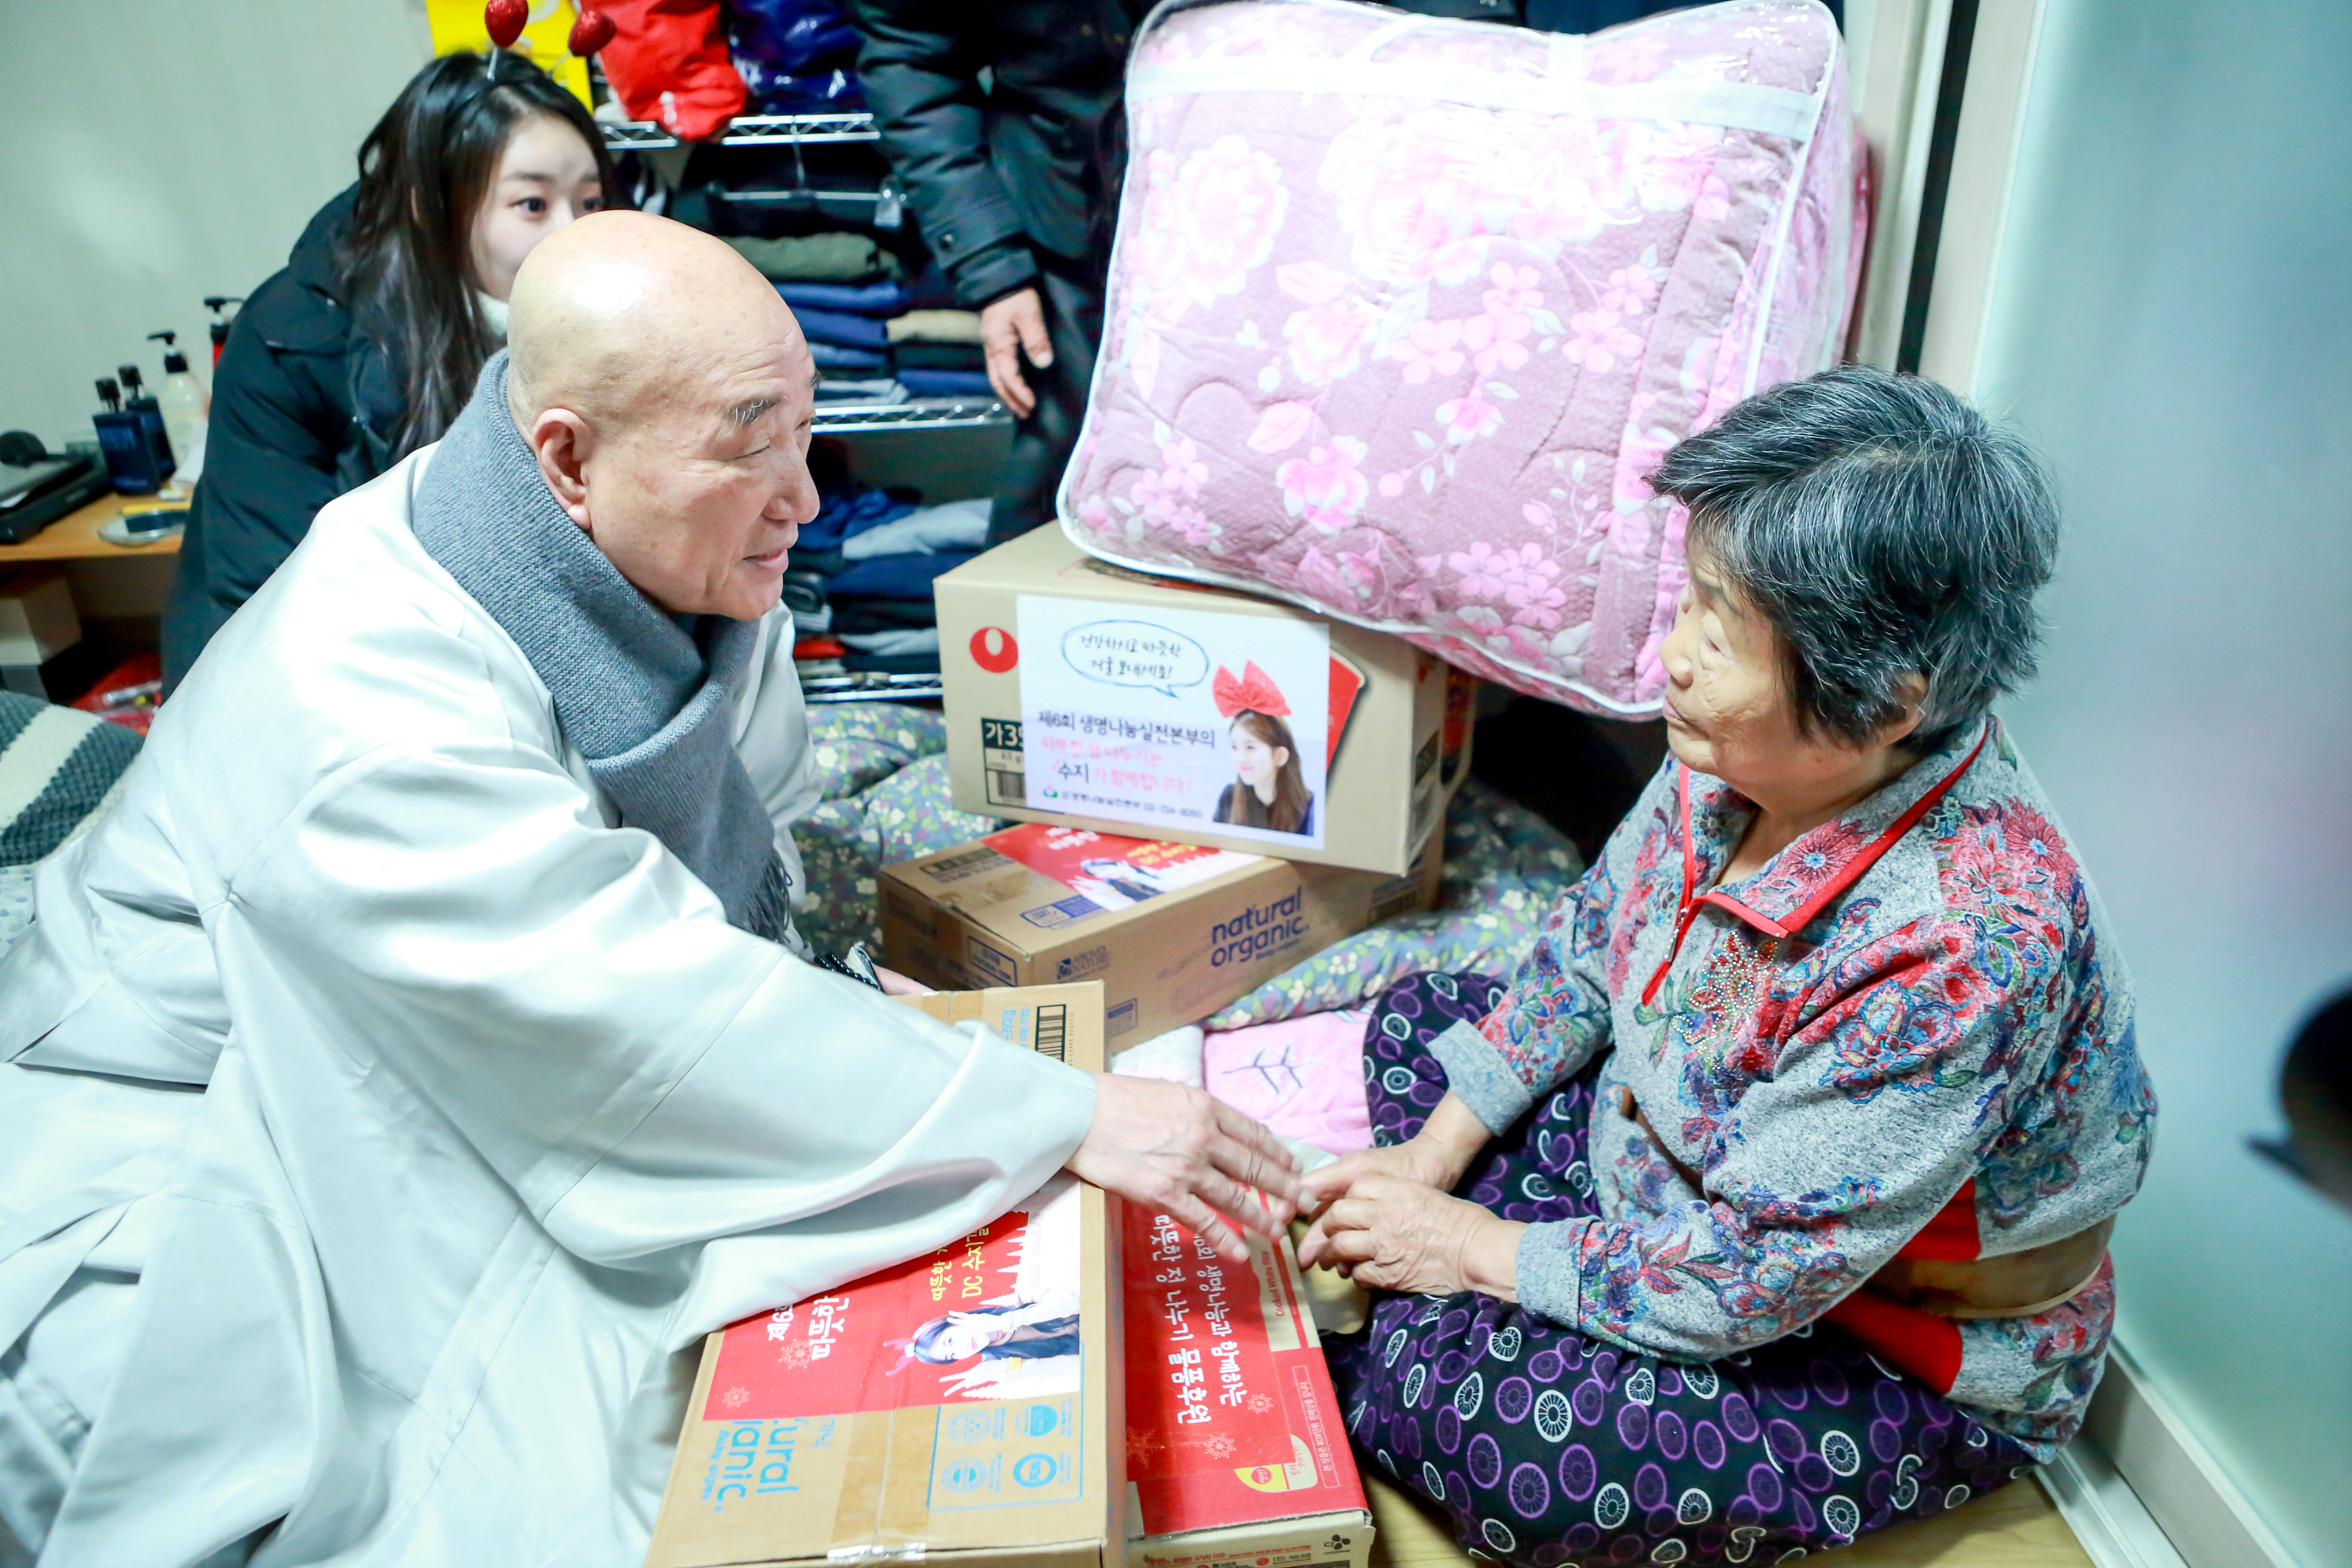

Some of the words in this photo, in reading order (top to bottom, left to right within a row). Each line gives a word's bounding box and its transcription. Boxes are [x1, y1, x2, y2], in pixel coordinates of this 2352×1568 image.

[1212, 885, 1301, 944] natural
[1211, 916, 1305, 967] organic
[1149, 1215, 1181, 1262] 따뜻한
[930, 1261, 952, 1301] 따뜻한
[962, 1276, 983, 1298] DC
[1155, 1268, 1186, 1284] 정
[1196, 1265, 1232, 1337] 생명나눔과
[808, 1295, 849, 1359] 따뜻한
[1164, 1290, 1193, 1341] 나누기
[1269, 1289, 1285, 1316] Cooked
[1168, 1348, 1212, 1425] 물품후원
[1211, 1341, 1247, 1407] 함께하는
[756, 1419, 799, 1493] ural
